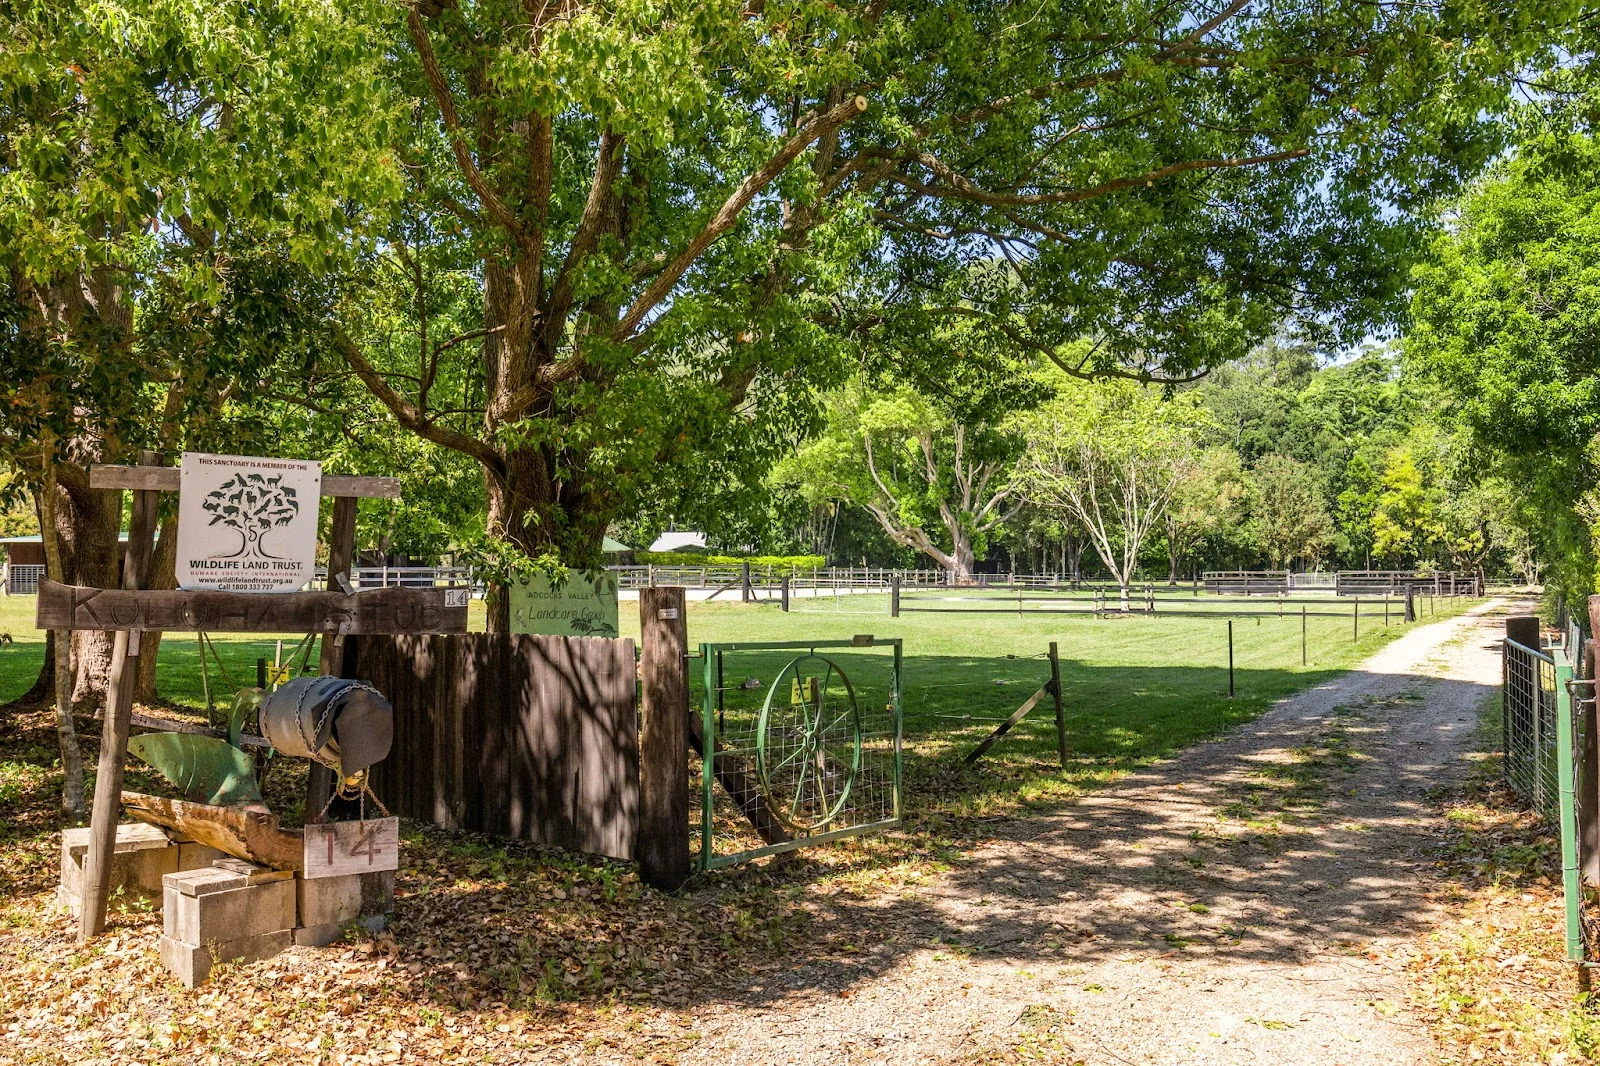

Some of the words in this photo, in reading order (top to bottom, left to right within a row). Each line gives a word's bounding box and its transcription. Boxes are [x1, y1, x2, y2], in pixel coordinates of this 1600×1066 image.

[213, 459, 249, 467] SANCTUARY
[190, 560, 239, 569] WILDLIFE
[242, 561, 269, 570] LAND
[198, 577, 293, 585] www.wildlifelandtrust.org.au
[446, 590, 469, 606] 14
[528, 591, 562, 600] ADCOCKS
[568, 592, 594, 600] VALLEY
[528, 606, 578, 620] Landcare
[581, 606, 605, 623] Group
[327, 828, 382, 866] 14
